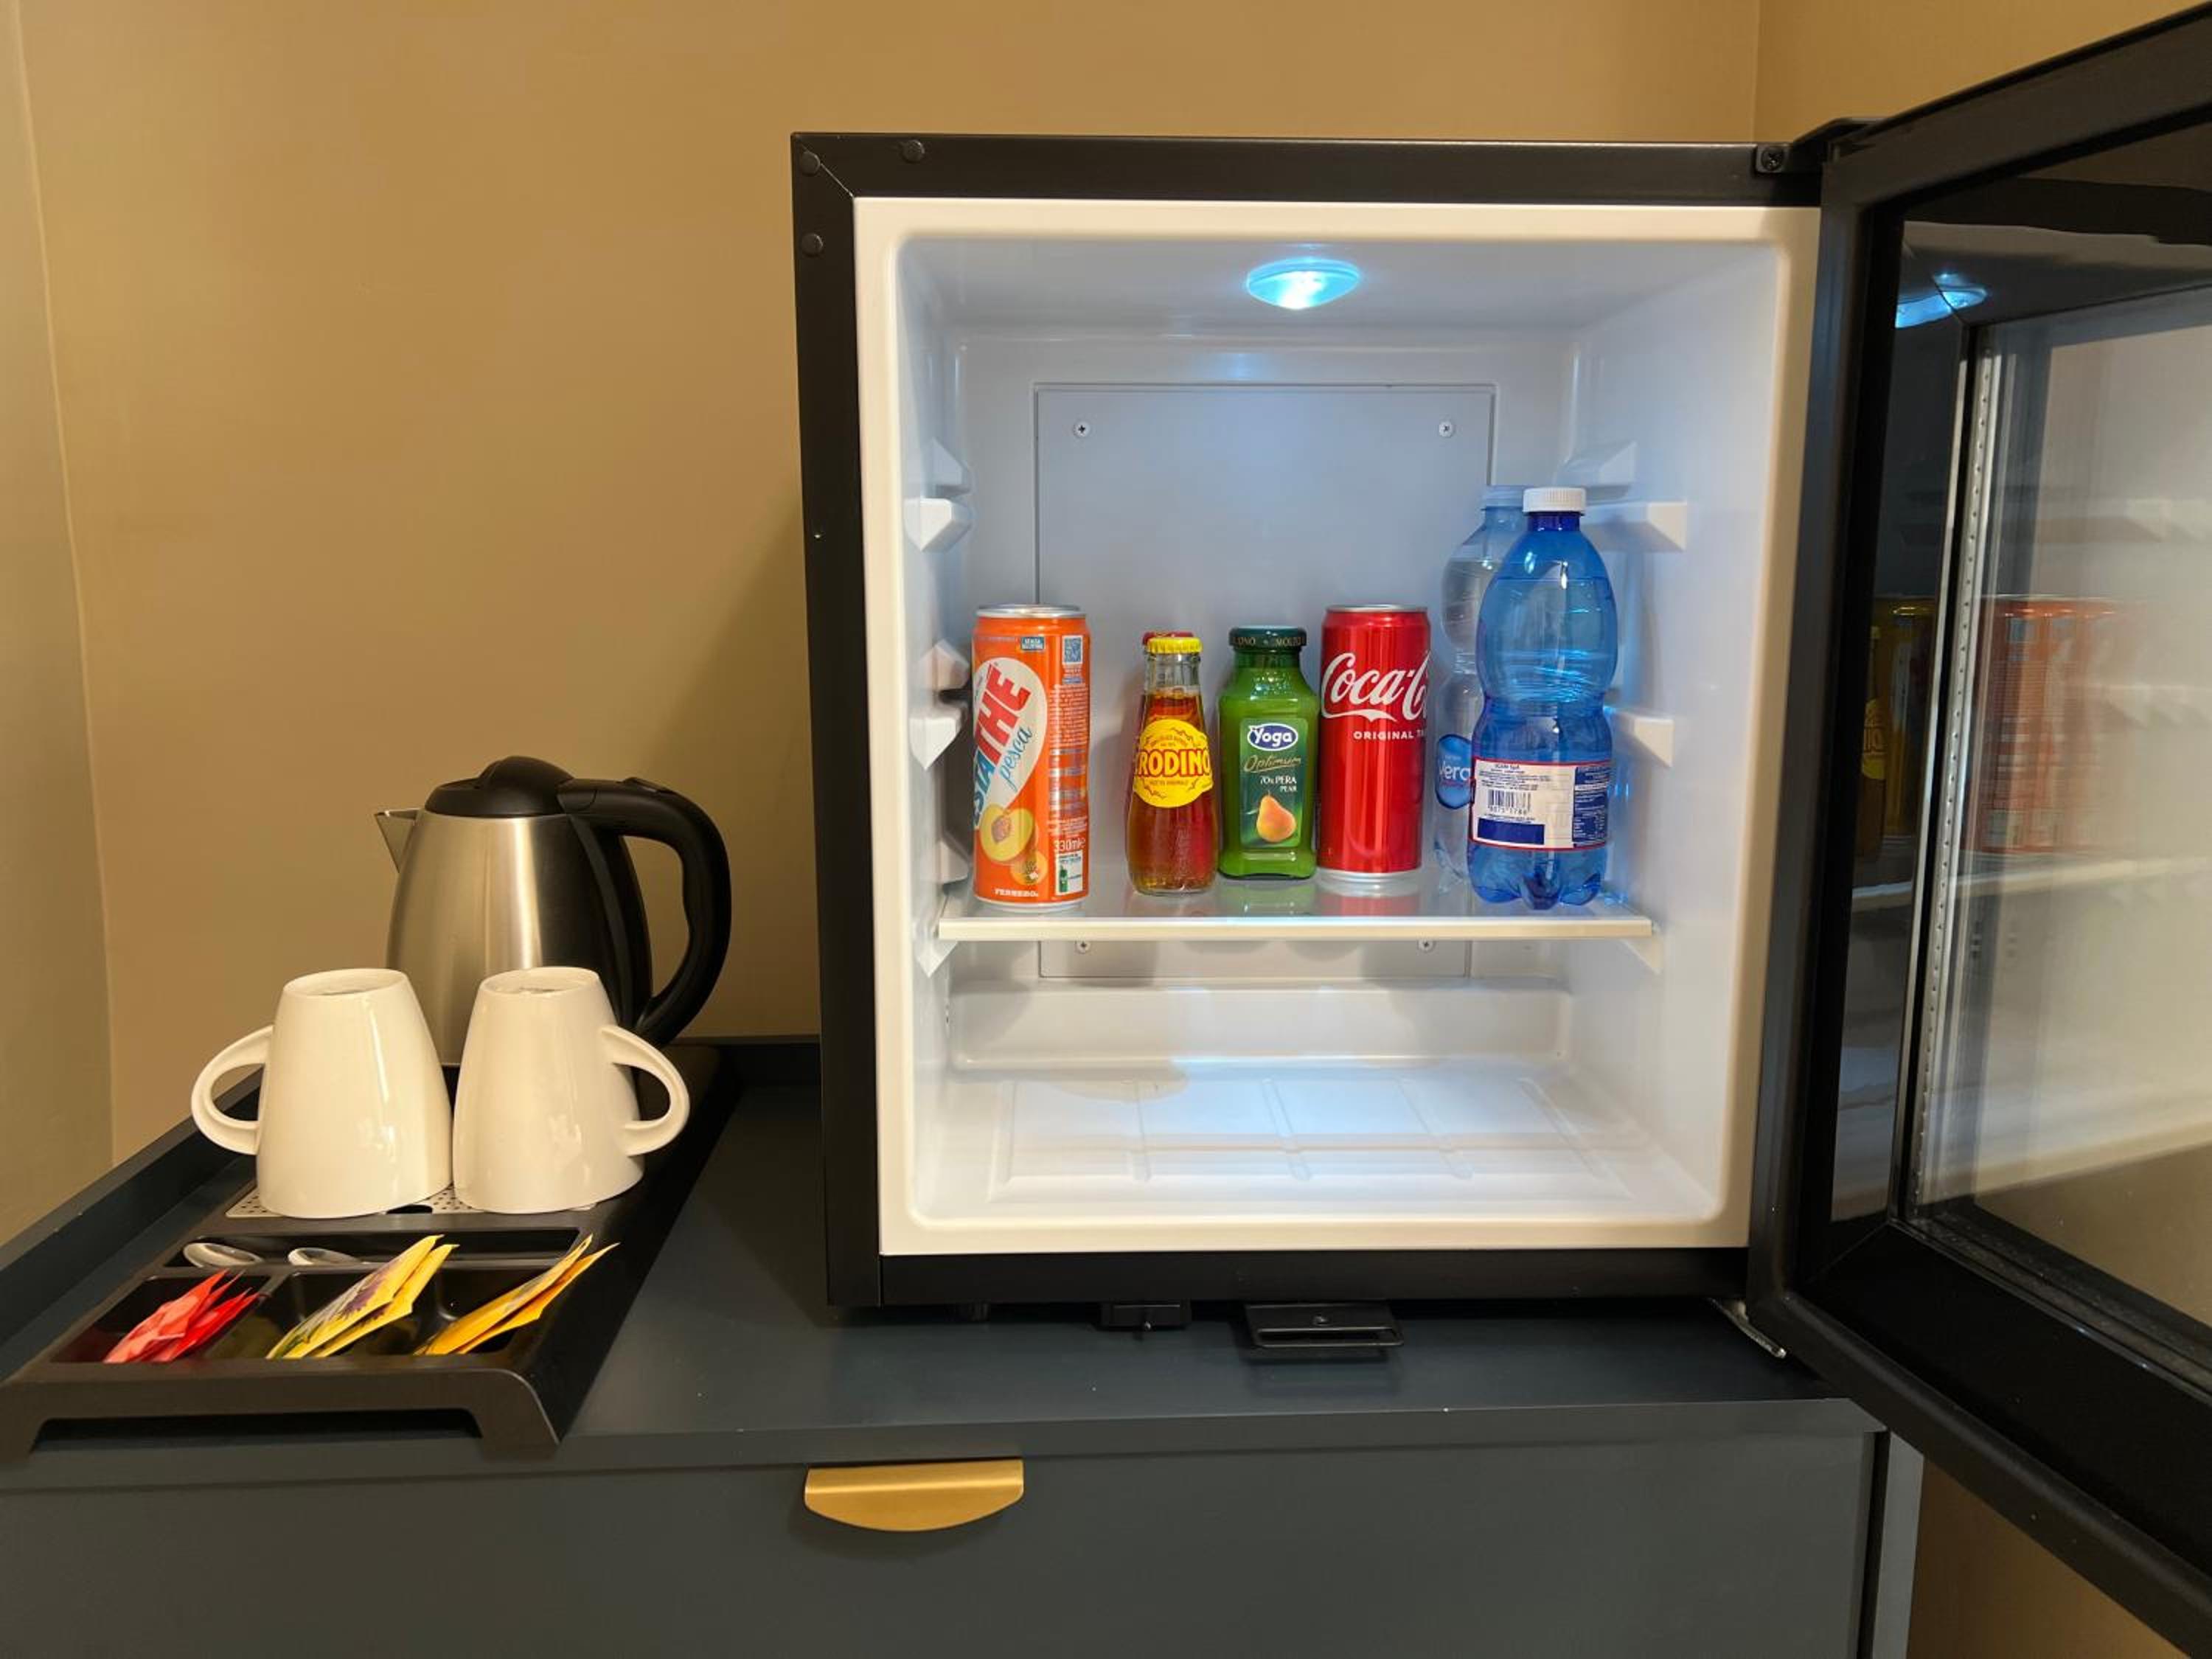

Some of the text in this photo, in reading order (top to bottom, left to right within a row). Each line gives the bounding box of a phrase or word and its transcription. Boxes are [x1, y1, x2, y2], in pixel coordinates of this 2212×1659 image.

[1251, 726, 1293, 747] Yoga
[1353, 731, 1414, 740] ORIGINAL
[1000, 726, 1032, 793] pesca
[1136, 748, 1211, 778] RODINO
[1275, 775, 1297, 785] PERA
